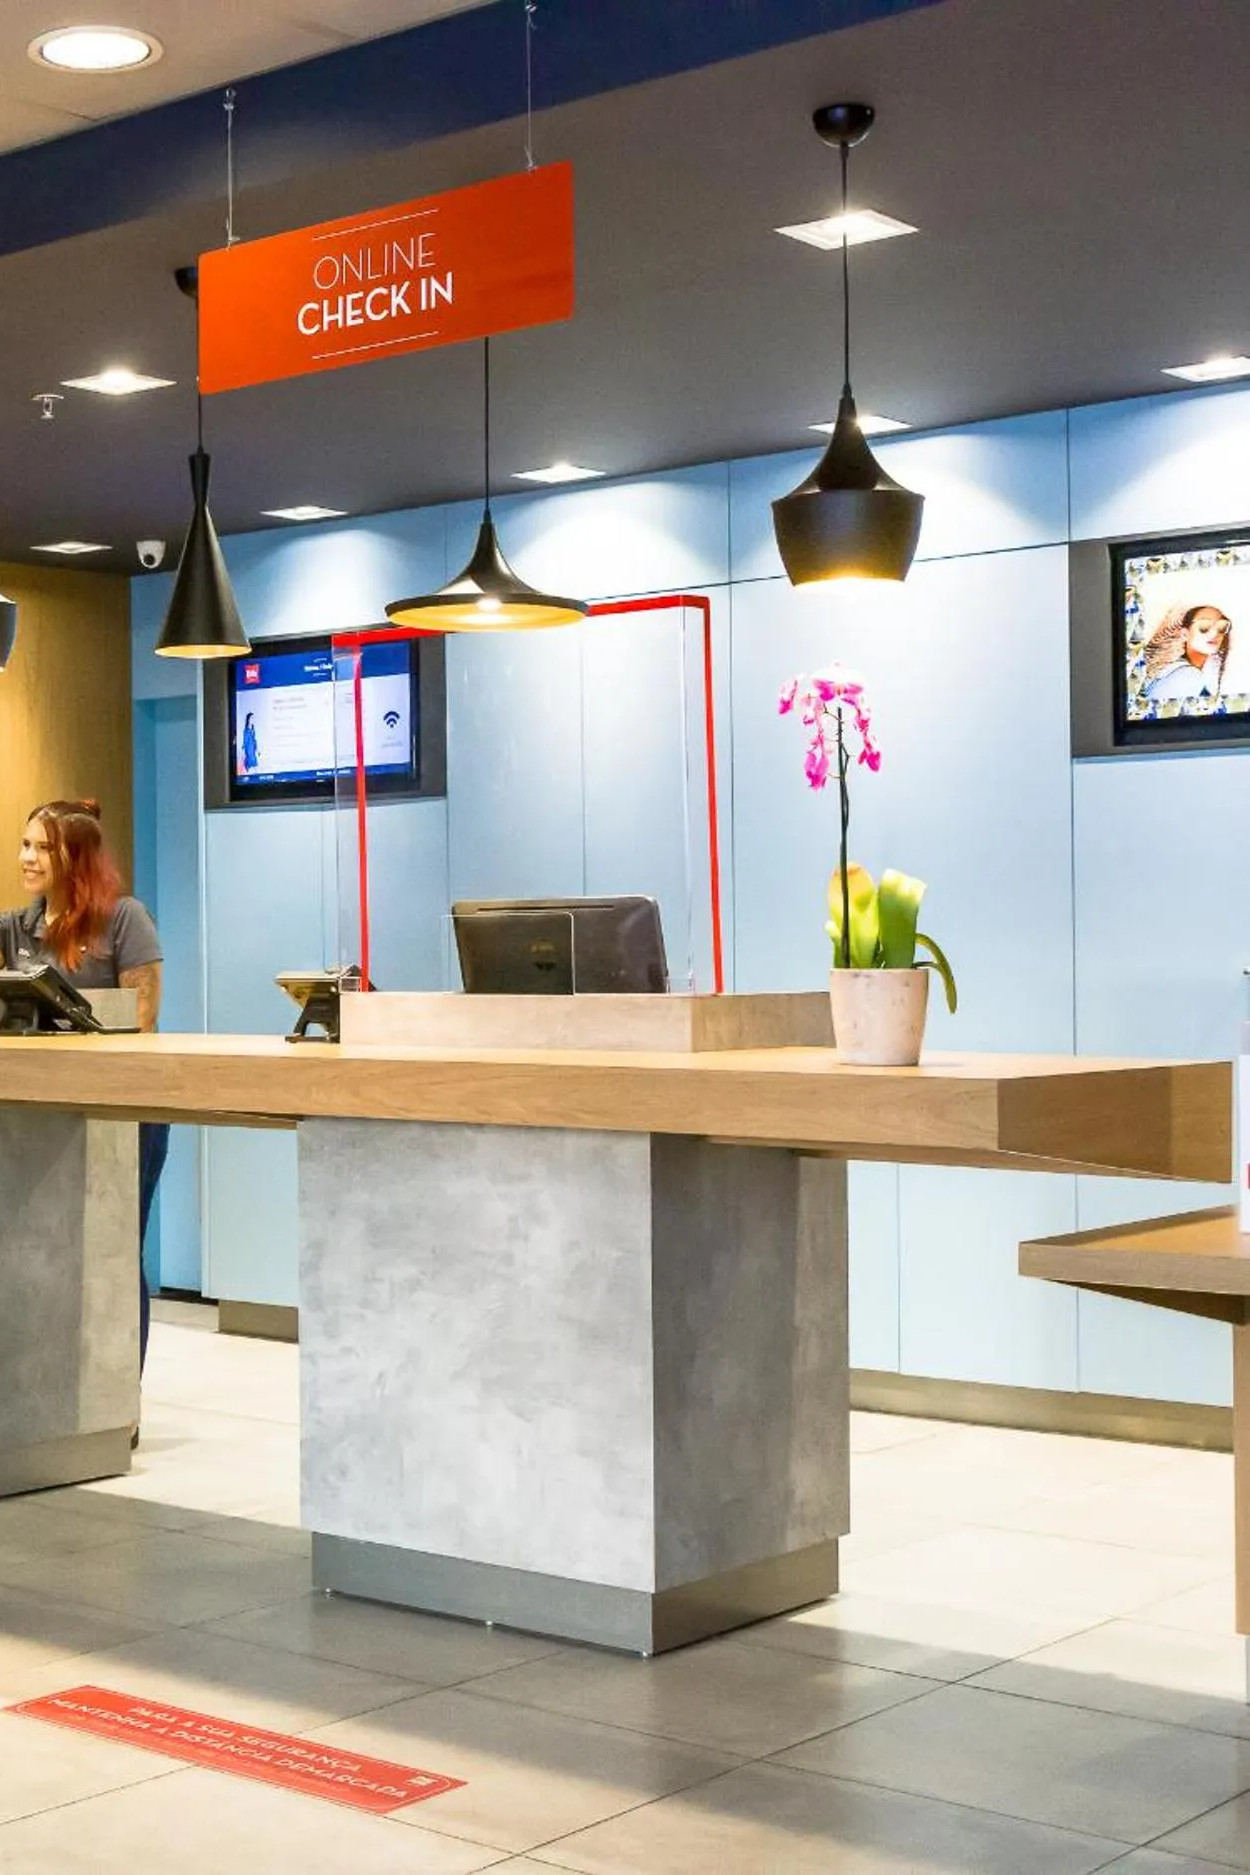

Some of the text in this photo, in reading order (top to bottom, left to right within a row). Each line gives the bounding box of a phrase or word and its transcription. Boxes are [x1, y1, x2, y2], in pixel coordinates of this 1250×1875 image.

[313, 233, 436, 290] ONLINE
[297, 272, 454, 336] CHECK IN
